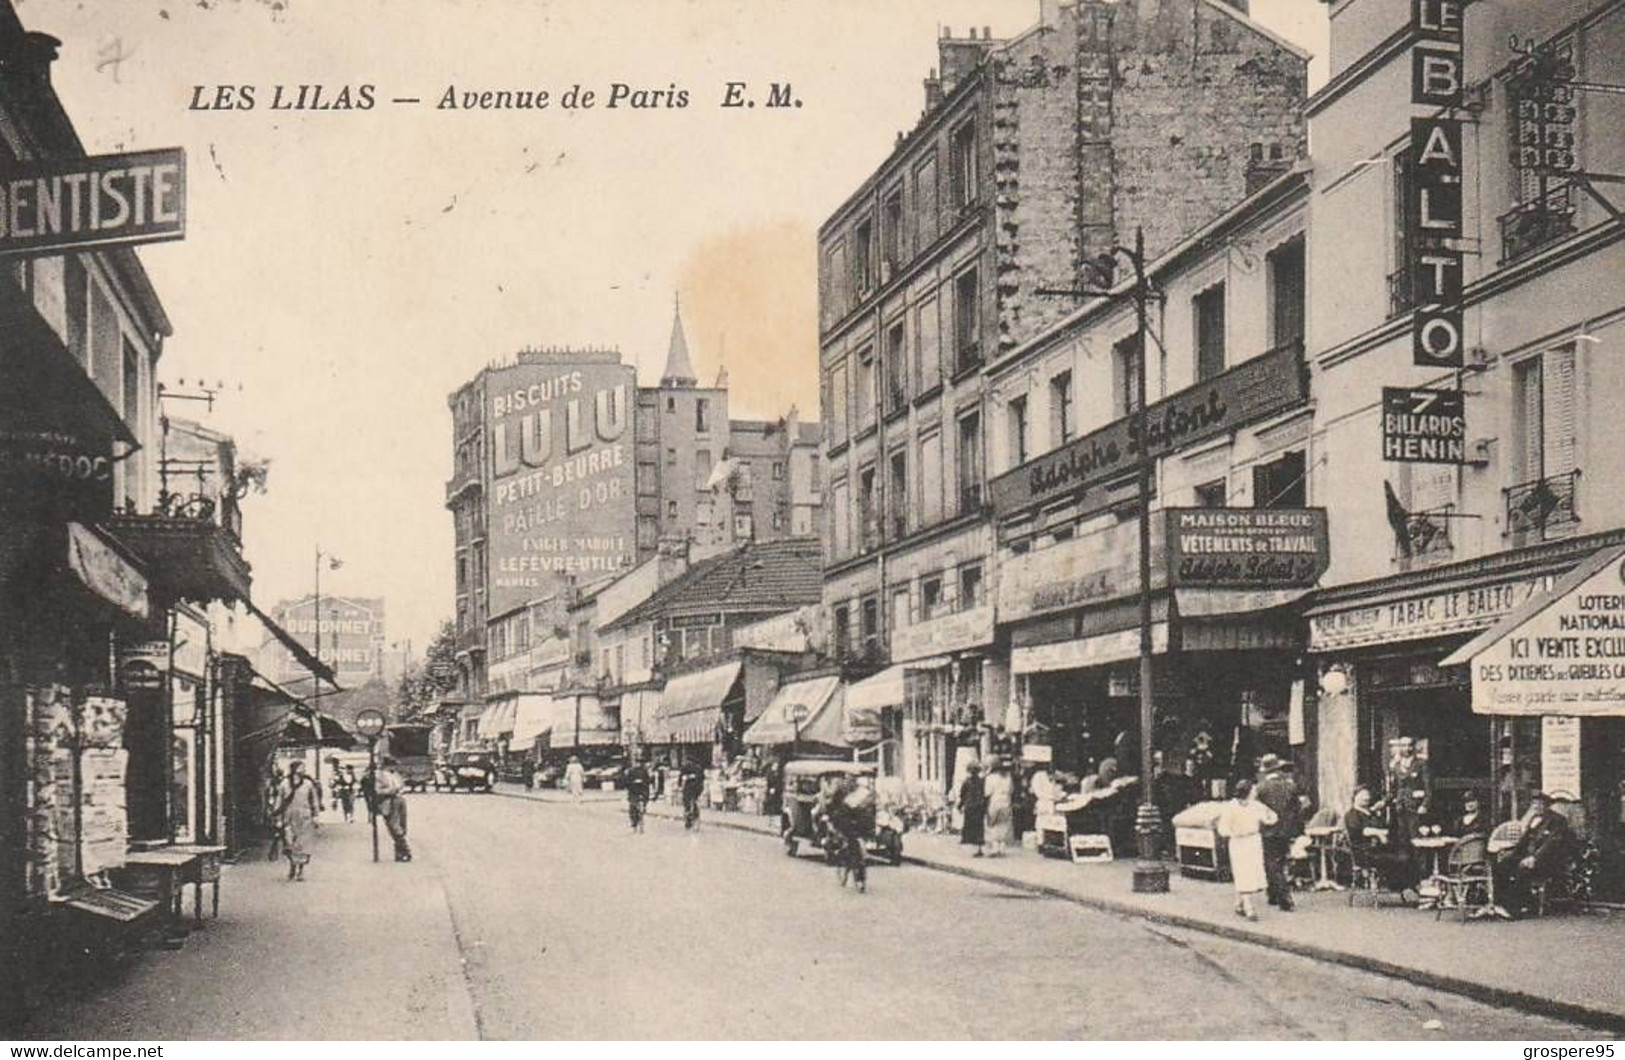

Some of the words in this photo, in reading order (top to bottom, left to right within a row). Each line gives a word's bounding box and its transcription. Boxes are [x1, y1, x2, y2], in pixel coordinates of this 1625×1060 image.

[1420, 0, 1460, 31] LE
[1420, 56, 1459, 358] BALTO
[493, 371, 582, 418] BISCUITS
[1385, 413, 1463, 437] BILLARDS
[496, 445, 623, 504] PETIT-BEURRE
[1180, 514, 1250, 527] MAISON
[1269, 534, 1317, 553] TRAVAIL
[1389, 599, 1436, 627] TABAC
[1444, 593, 1459, 619] LE
[1467, 584, 1514, 614] BALTO
[1511, 637, 1530, 658] ICI
[1537, 637, 1580, 658] VENTE
[1480, 665, 1503, 681] DES
